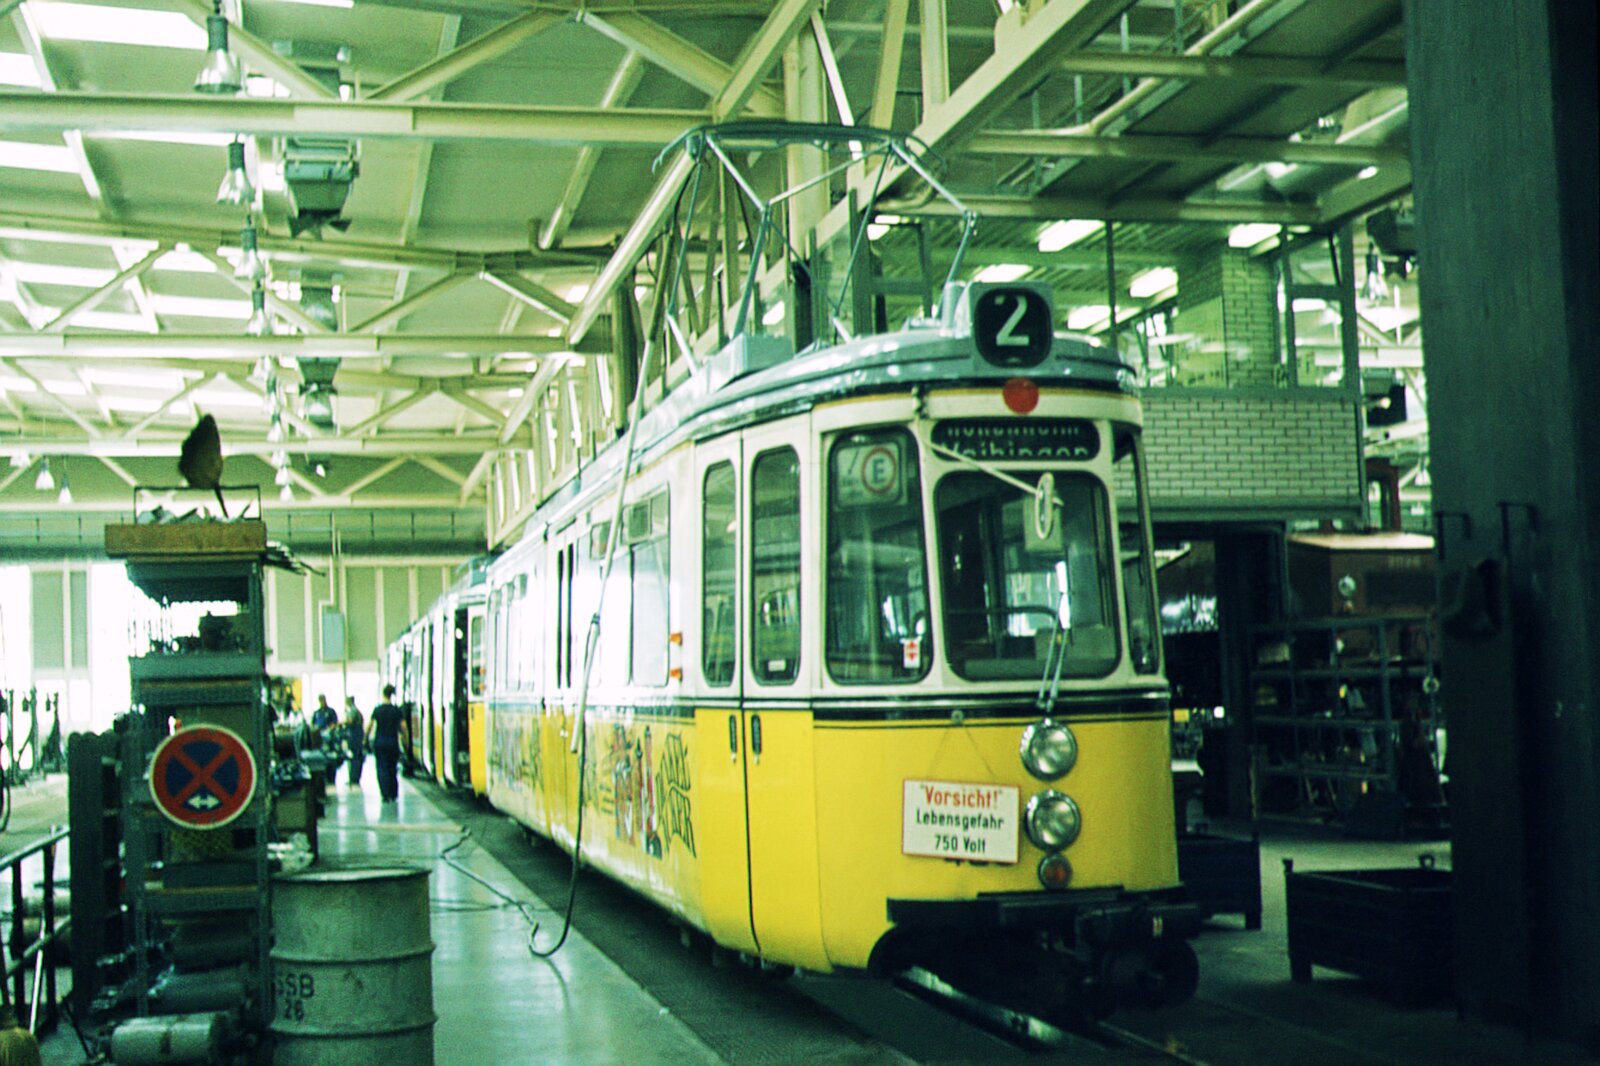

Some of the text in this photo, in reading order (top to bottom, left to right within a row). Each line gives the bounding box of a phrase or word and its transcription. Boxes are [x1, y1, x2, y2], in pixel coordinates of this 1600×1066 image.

[994, 295, 1031, 347] 2
[871, 458, 886, 485] E
[925, 784, 998, 810] Vorsicht!
[916, 807, 1005, 832] Lebensgefahr
[935, 833, 986, 854] 750 Volt
